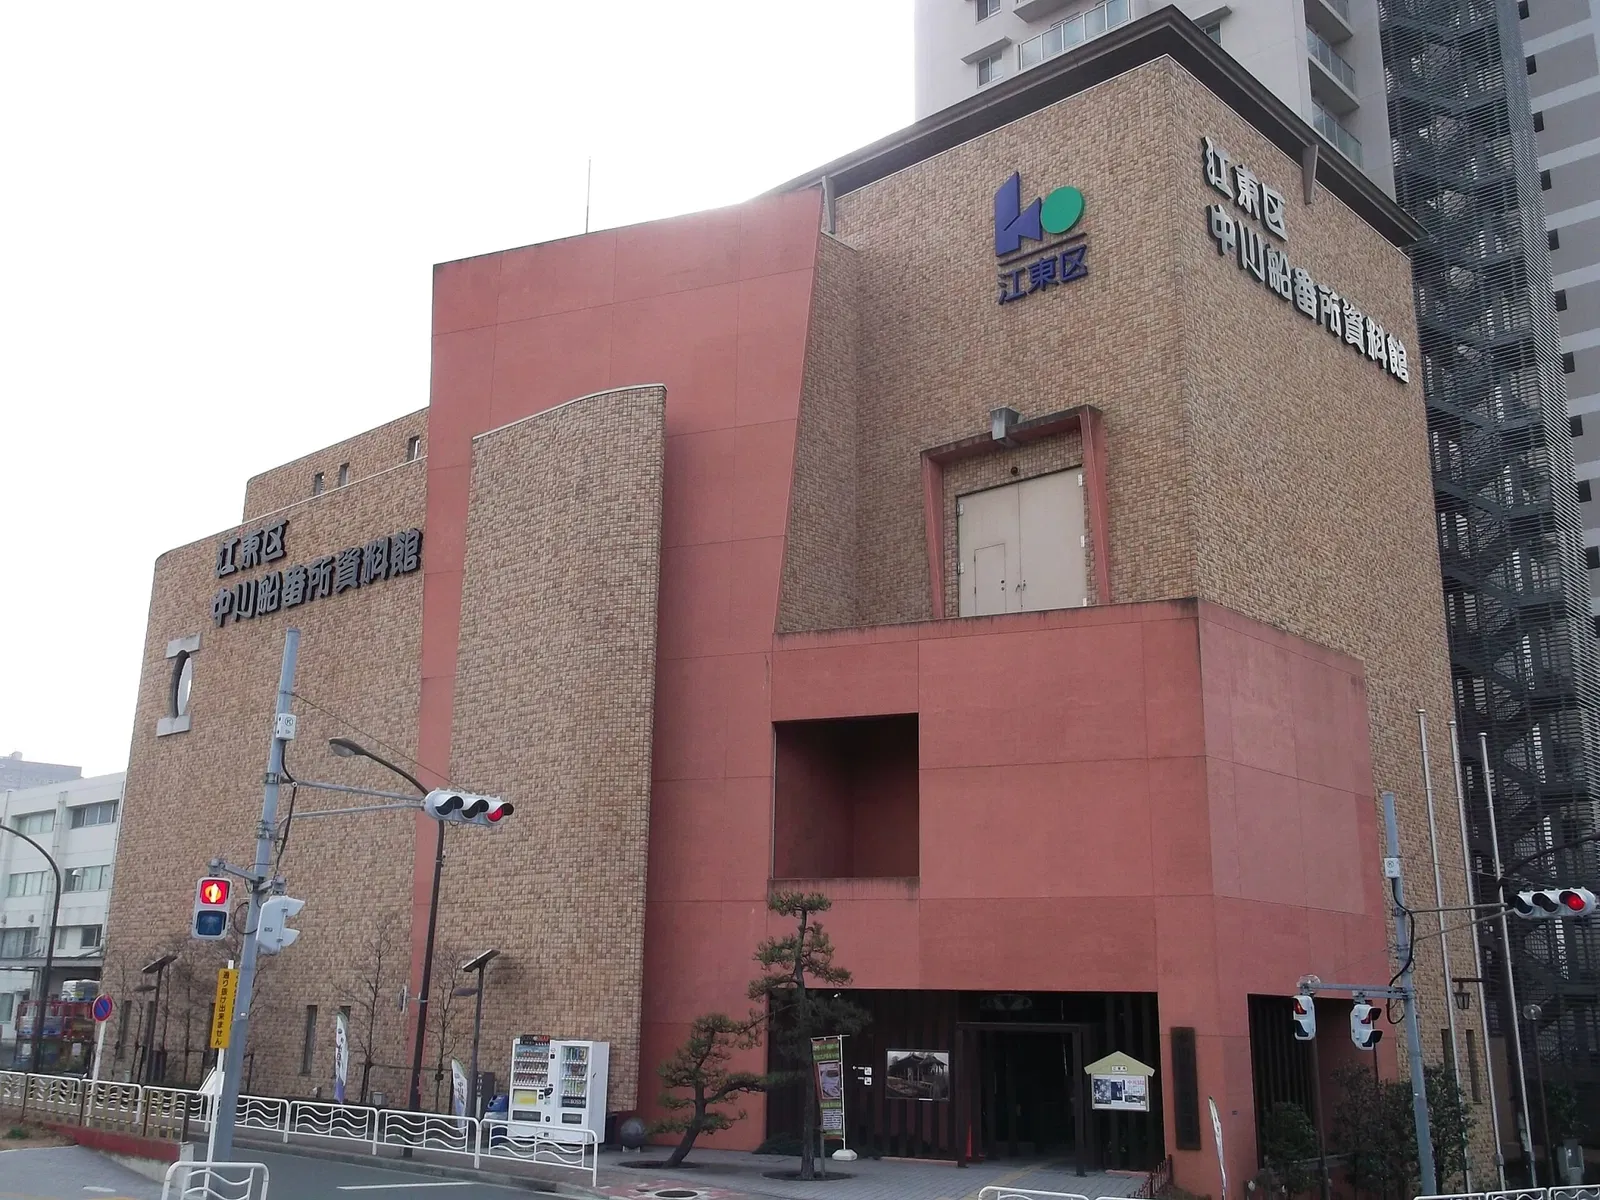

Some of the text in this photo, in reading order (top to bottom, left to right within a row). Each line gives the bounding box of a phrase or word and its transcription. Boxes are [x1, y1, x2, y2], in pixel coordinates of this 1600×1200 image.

[1201, 136, 1288, 241] 江東区
[998, 244, 1088, 305] 江東区
[1206, 203, 1410, 383] 中川船番所資料館
[211, 528, 423, 627] 中川船番所資料館
[215, 518, 289, 578] 江東区
